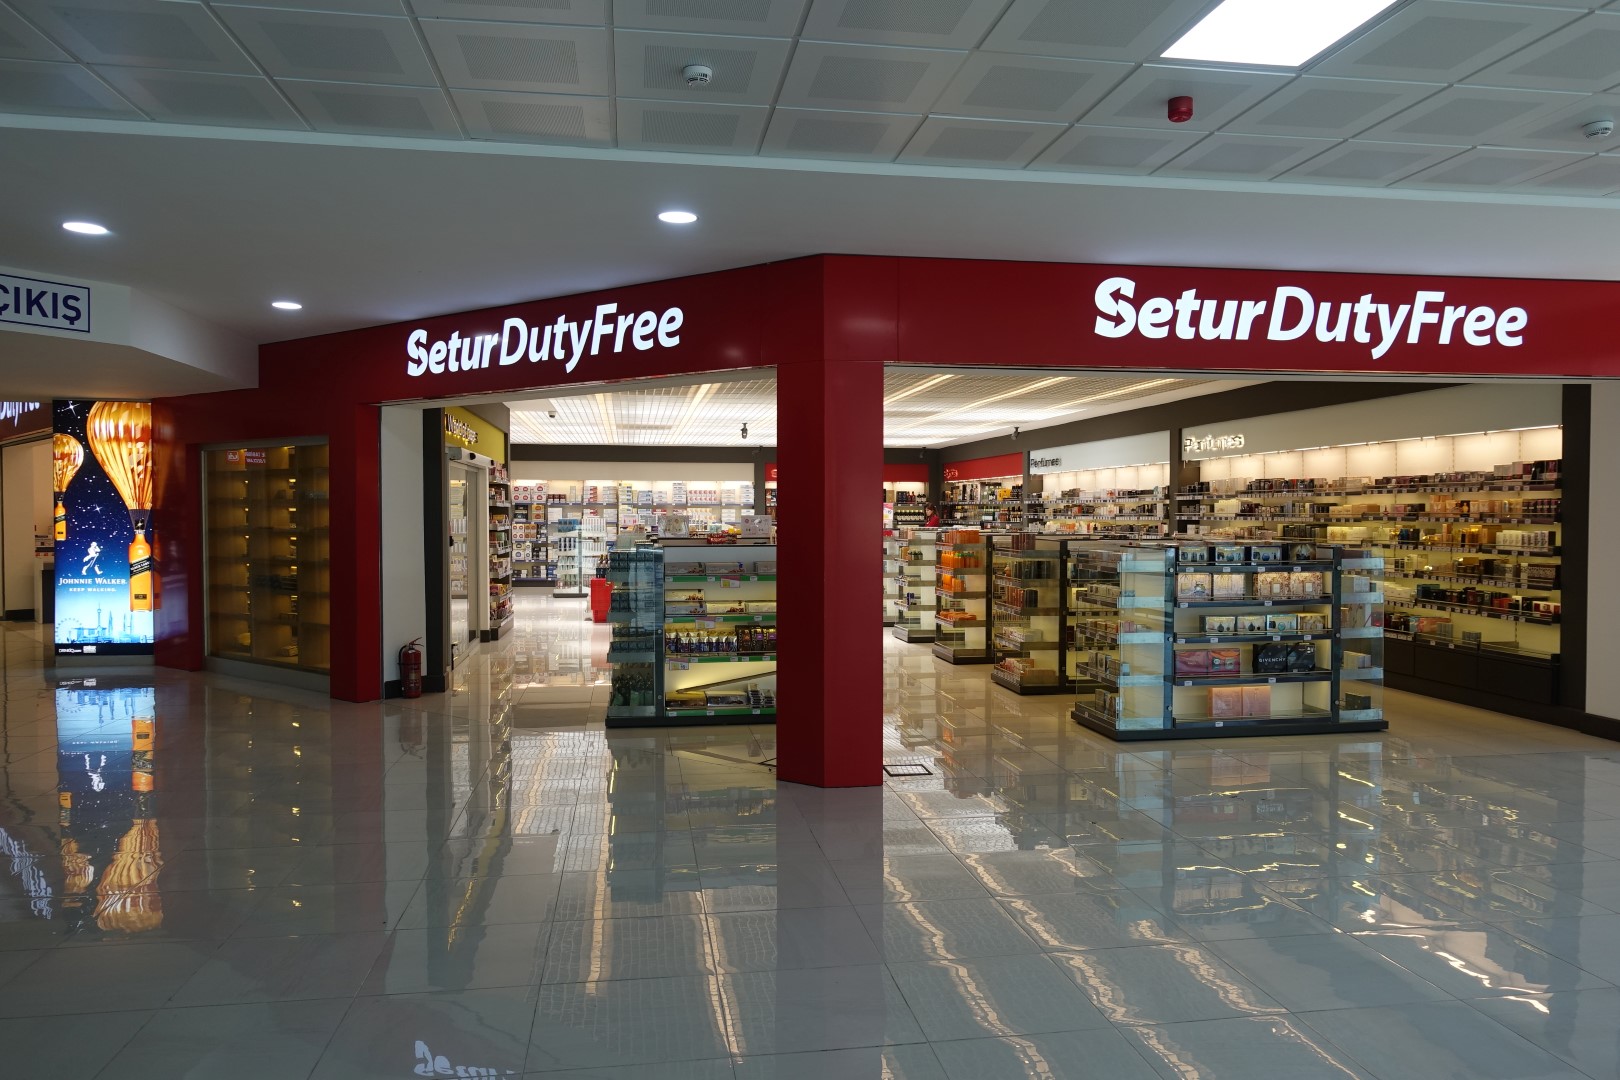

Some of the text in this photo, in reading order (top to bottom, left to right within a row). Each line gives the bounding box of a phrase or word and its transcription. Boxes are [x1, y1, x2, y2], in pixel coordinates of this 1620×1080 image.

[407, 302, 684, 377] SeturDutyFree
[1094, 276, 1528, 360] SeturDutyFree
[58, 577, 93, 586] JOHNNIE
